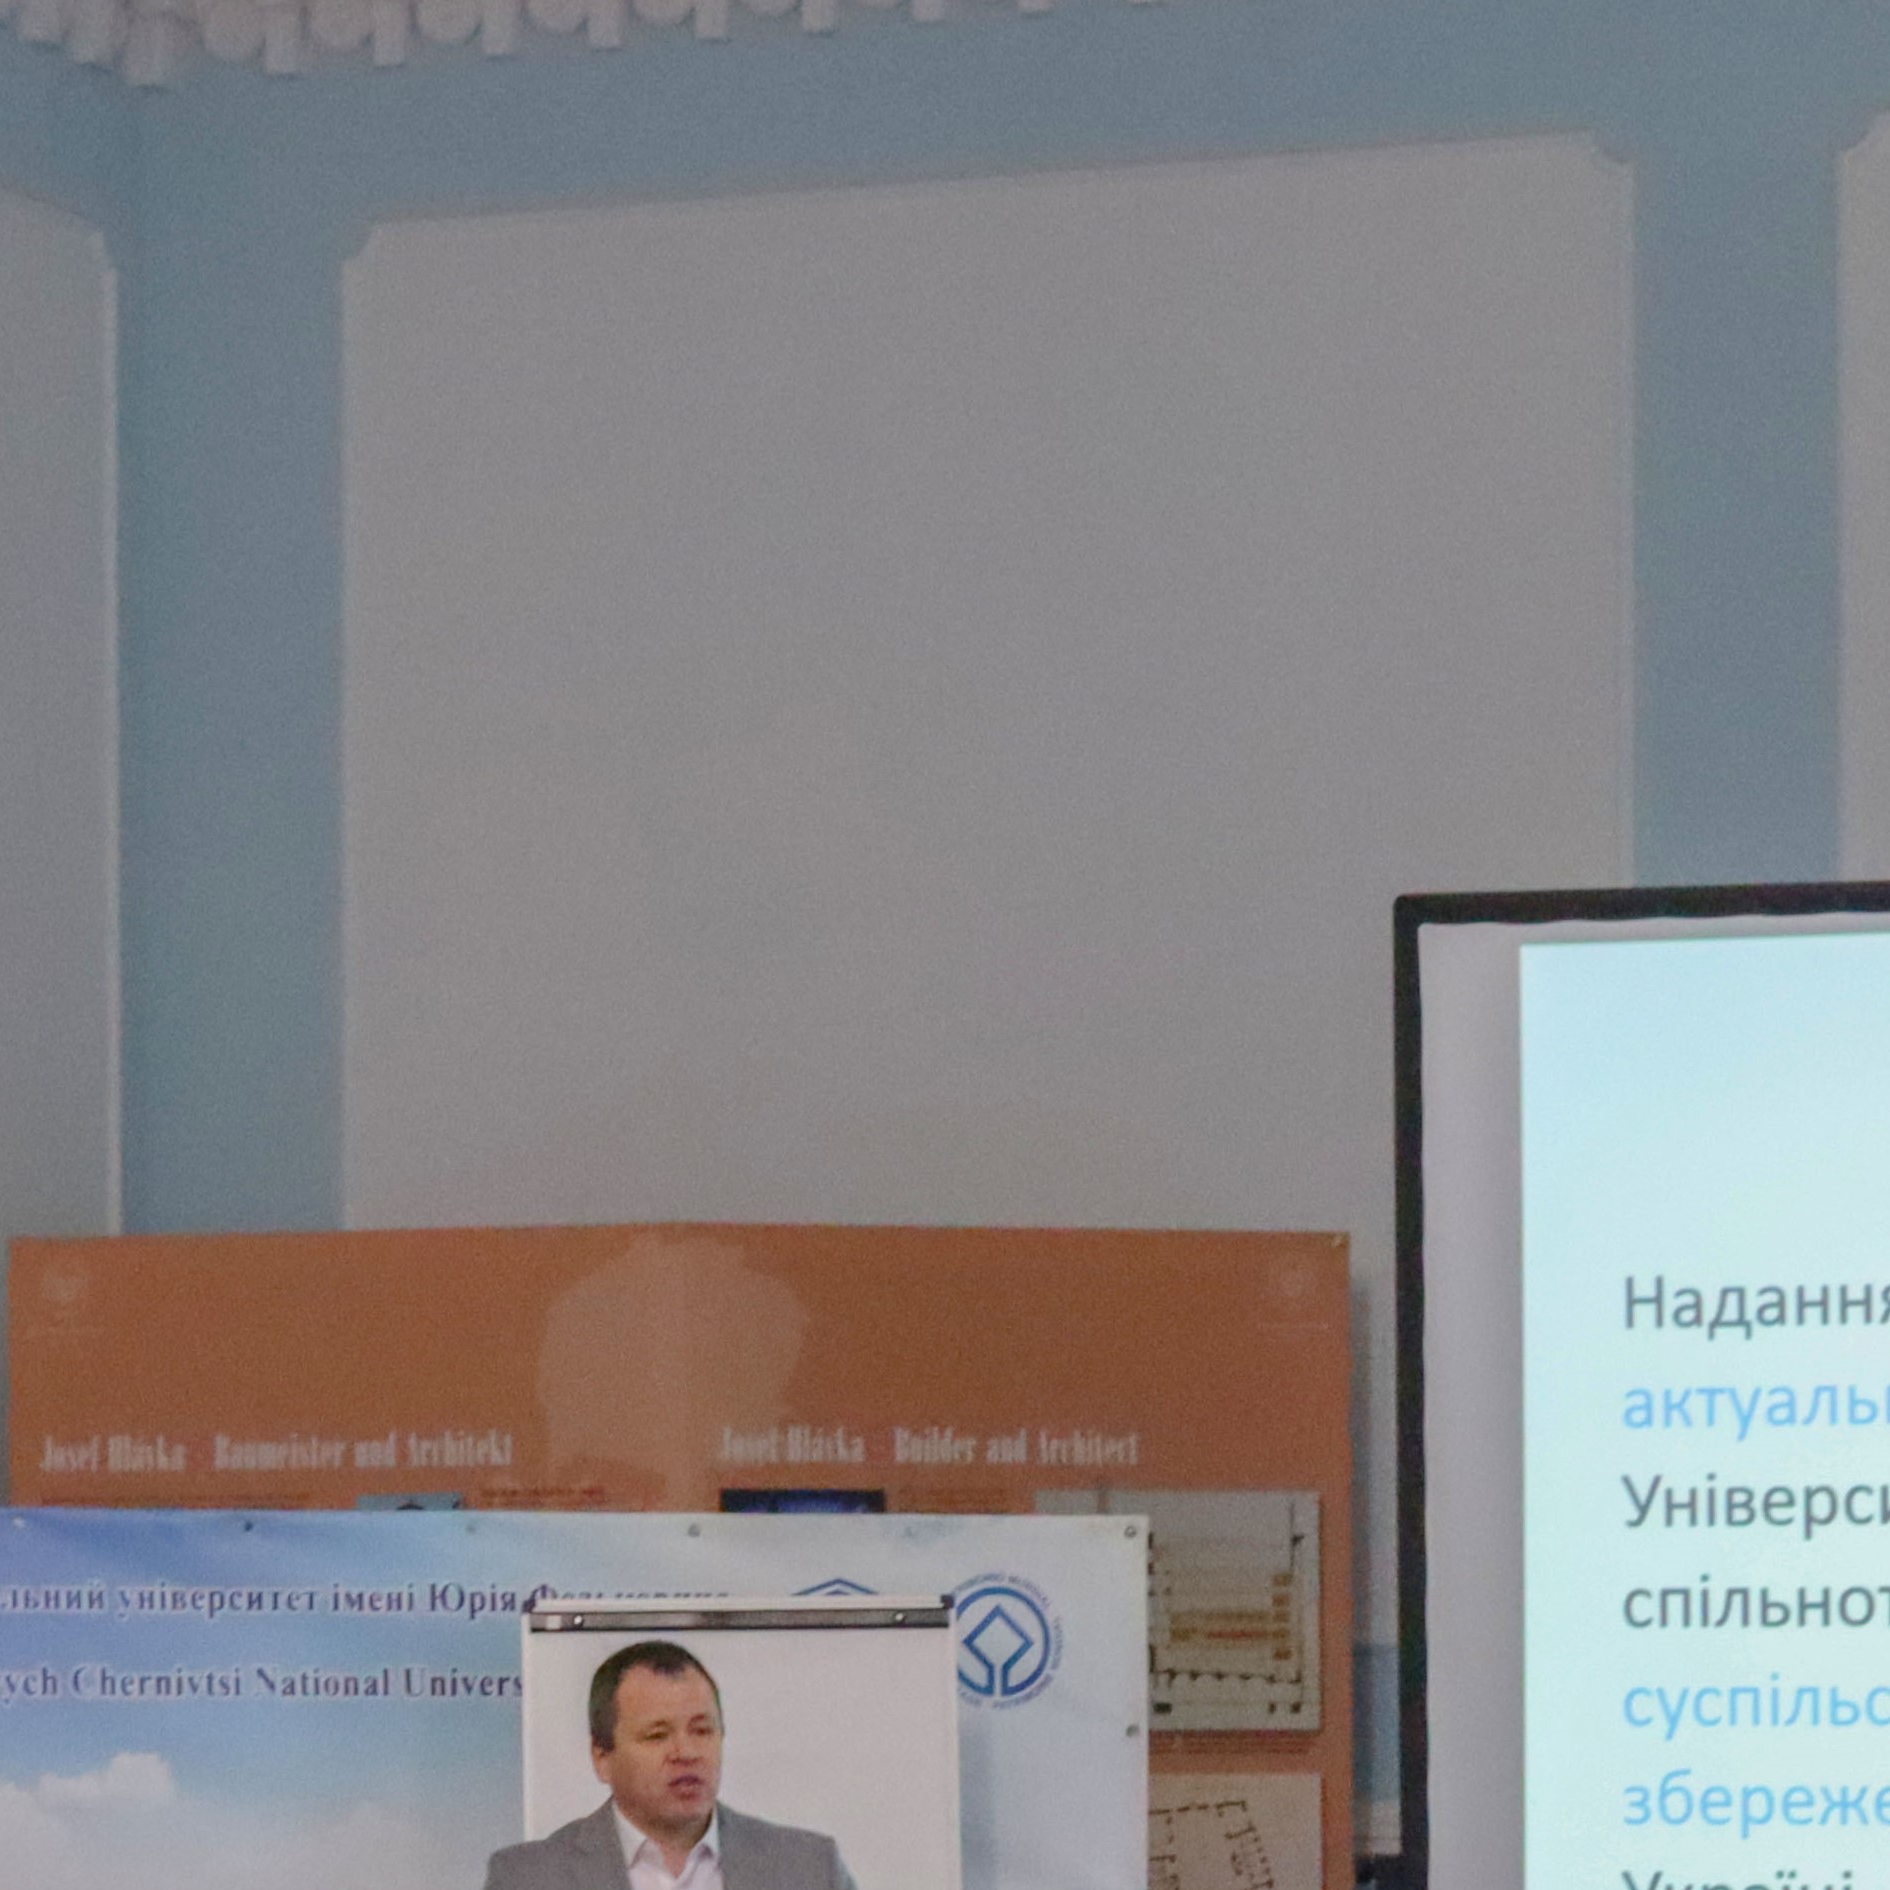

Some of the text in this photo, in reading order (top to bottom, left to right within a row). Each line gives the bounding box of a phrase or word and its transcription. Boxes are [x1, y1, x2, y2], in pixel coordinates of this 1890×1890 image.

[118, 1580, 317, 1618] університет
[330, 1582, 415, 1613] імені
[429, 1581, 517, 1620] Юрія
[73, 1666, 242, 1697] Chernivtsi
[256, 1667, 390, 1697] National
